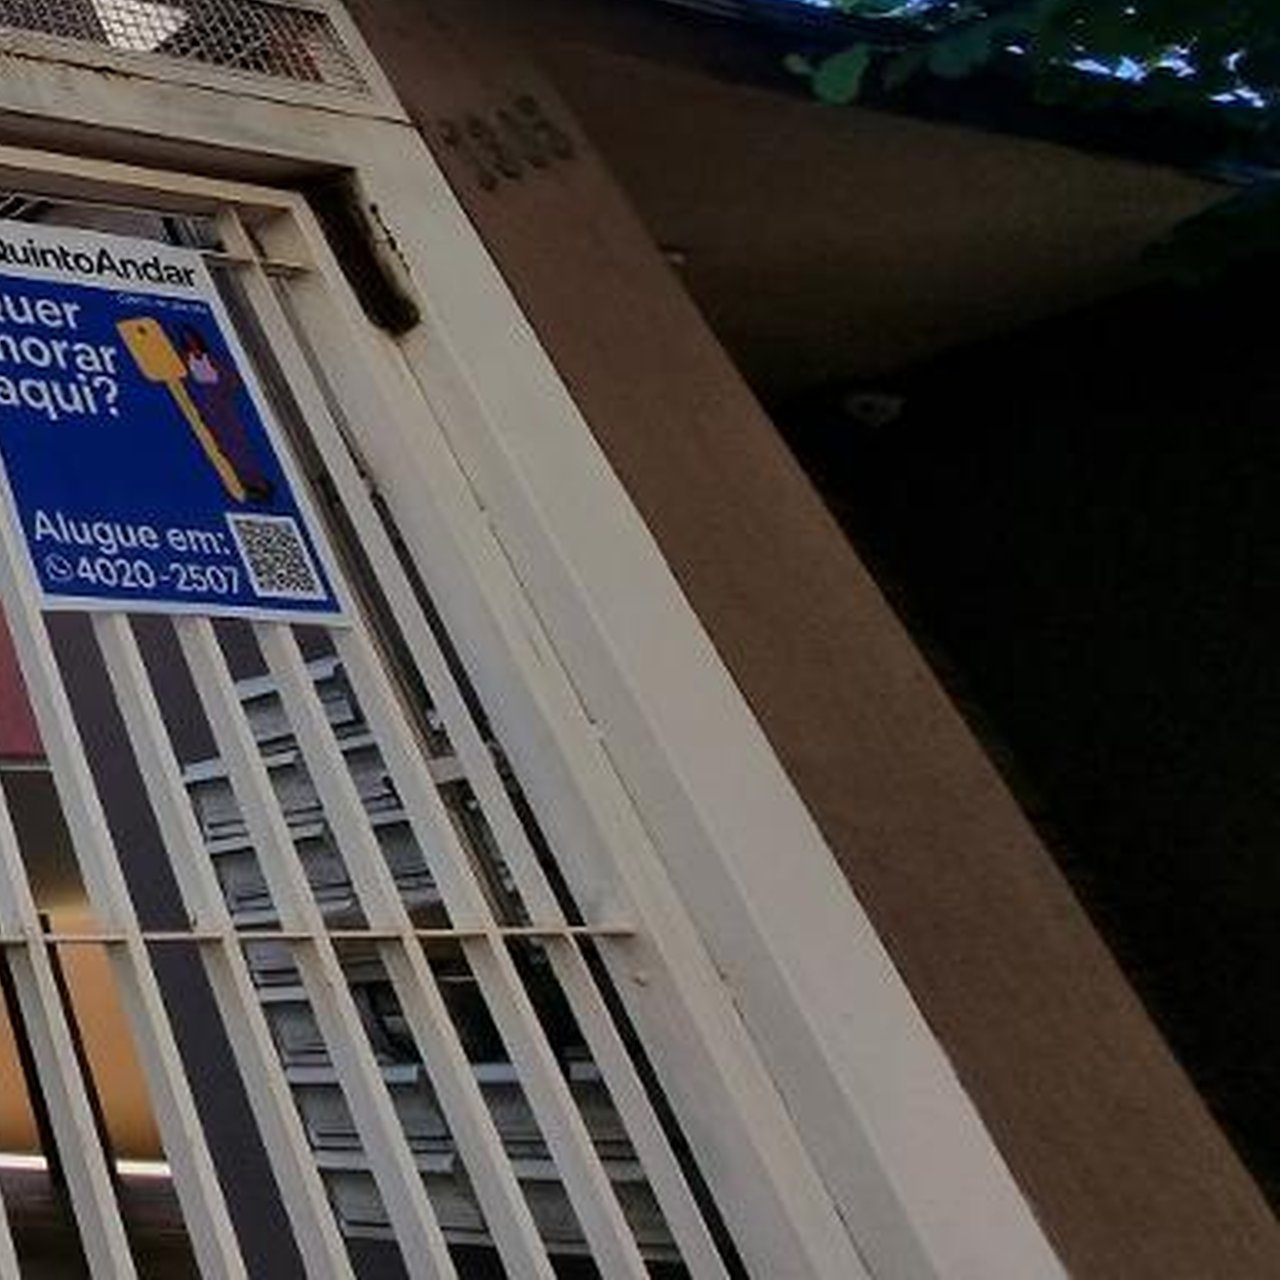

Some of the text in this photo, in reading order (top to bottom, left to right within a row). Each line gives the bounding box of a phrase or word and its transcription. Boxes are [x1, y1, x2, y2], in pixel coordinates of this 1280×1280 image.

[34, 508, 231, 555] Alugue em:
[76, 555, 239, 595] 4020-2507
